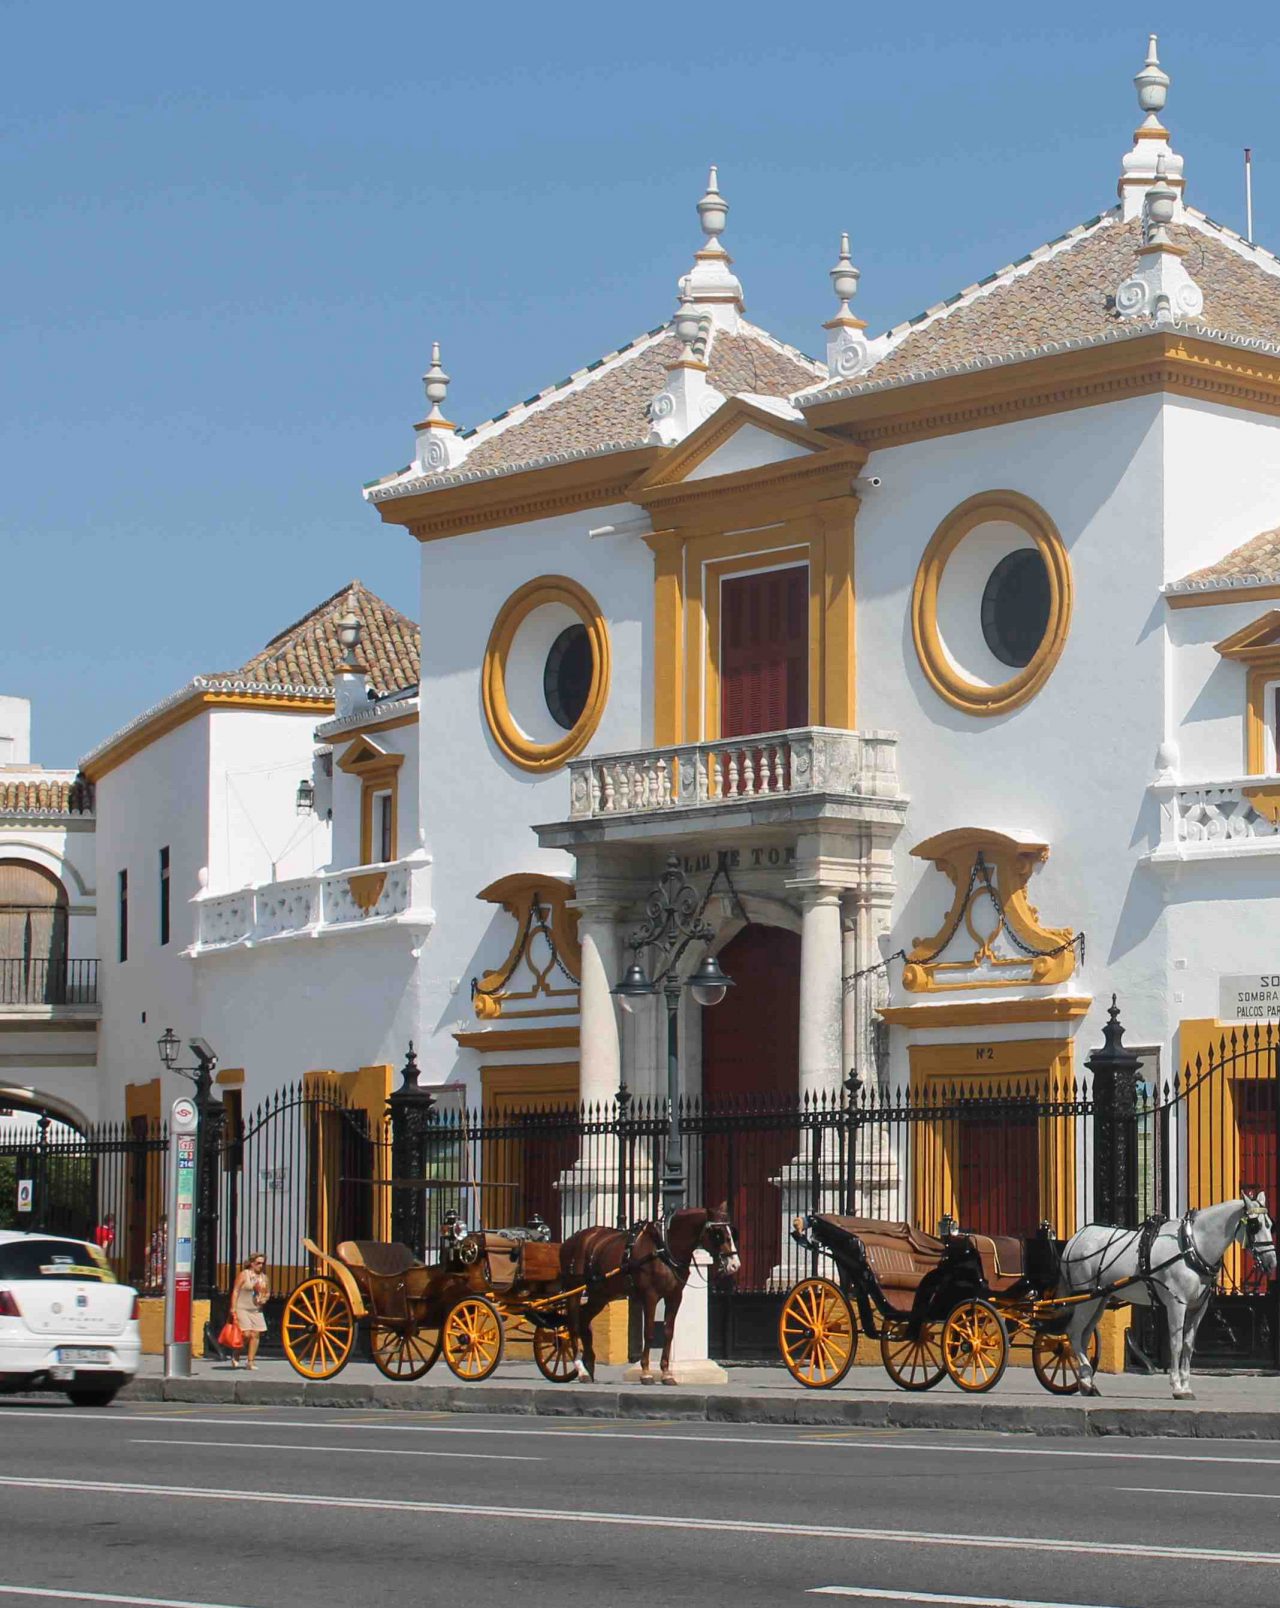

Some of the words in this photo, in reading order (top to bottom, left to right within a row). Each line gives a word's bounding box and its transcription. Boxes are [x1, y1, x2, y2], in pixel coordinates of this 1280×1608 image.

[1238, 991, 1278, 1002] SOMBRA
[1237, 1006, 1263, 1017] PALCOS
[987, 1048, 994, 1059] 2
